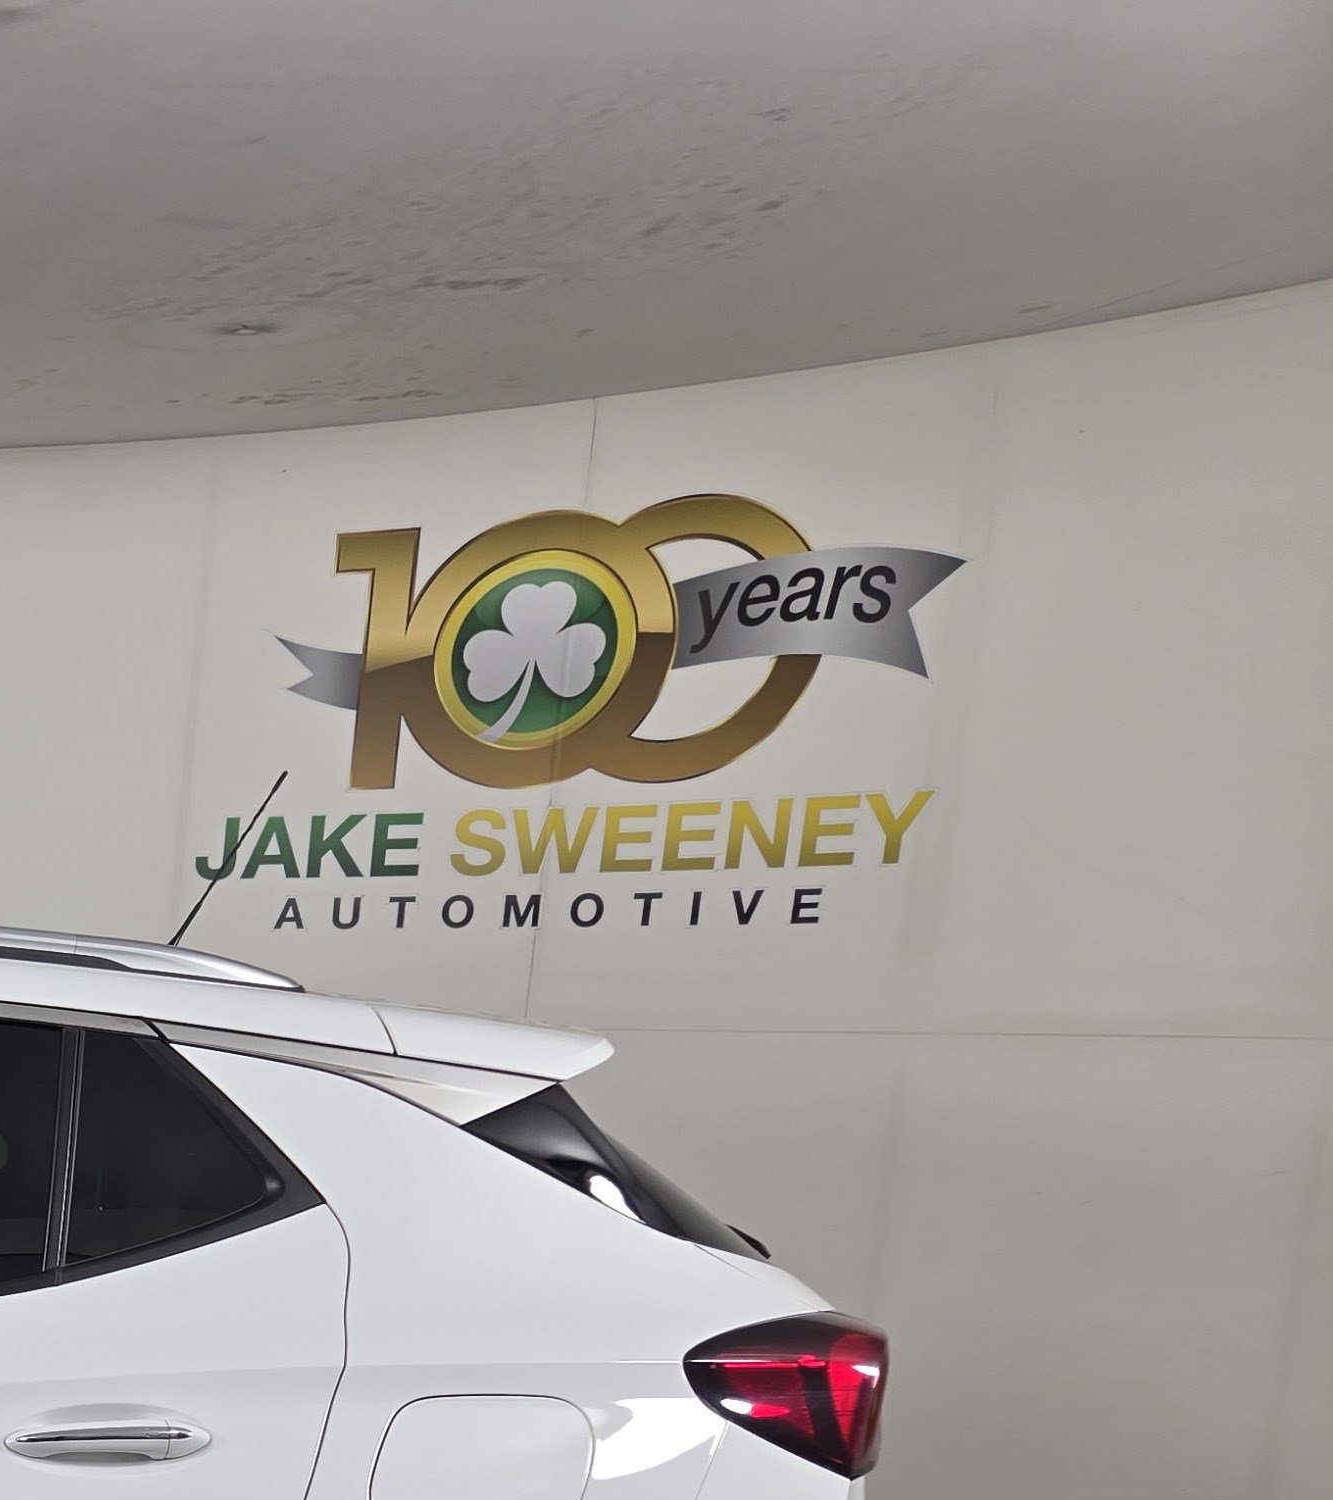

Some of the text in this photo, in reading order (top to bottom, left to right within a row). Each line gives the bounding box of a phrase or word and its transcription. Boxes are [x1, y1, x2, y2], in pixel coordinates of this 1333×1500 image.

[689, 563, 897, 653] years
[195, 789, 935, 881] JAKE SWEENEY
[274, 887, 824, 931] AUTOMOTIVE
